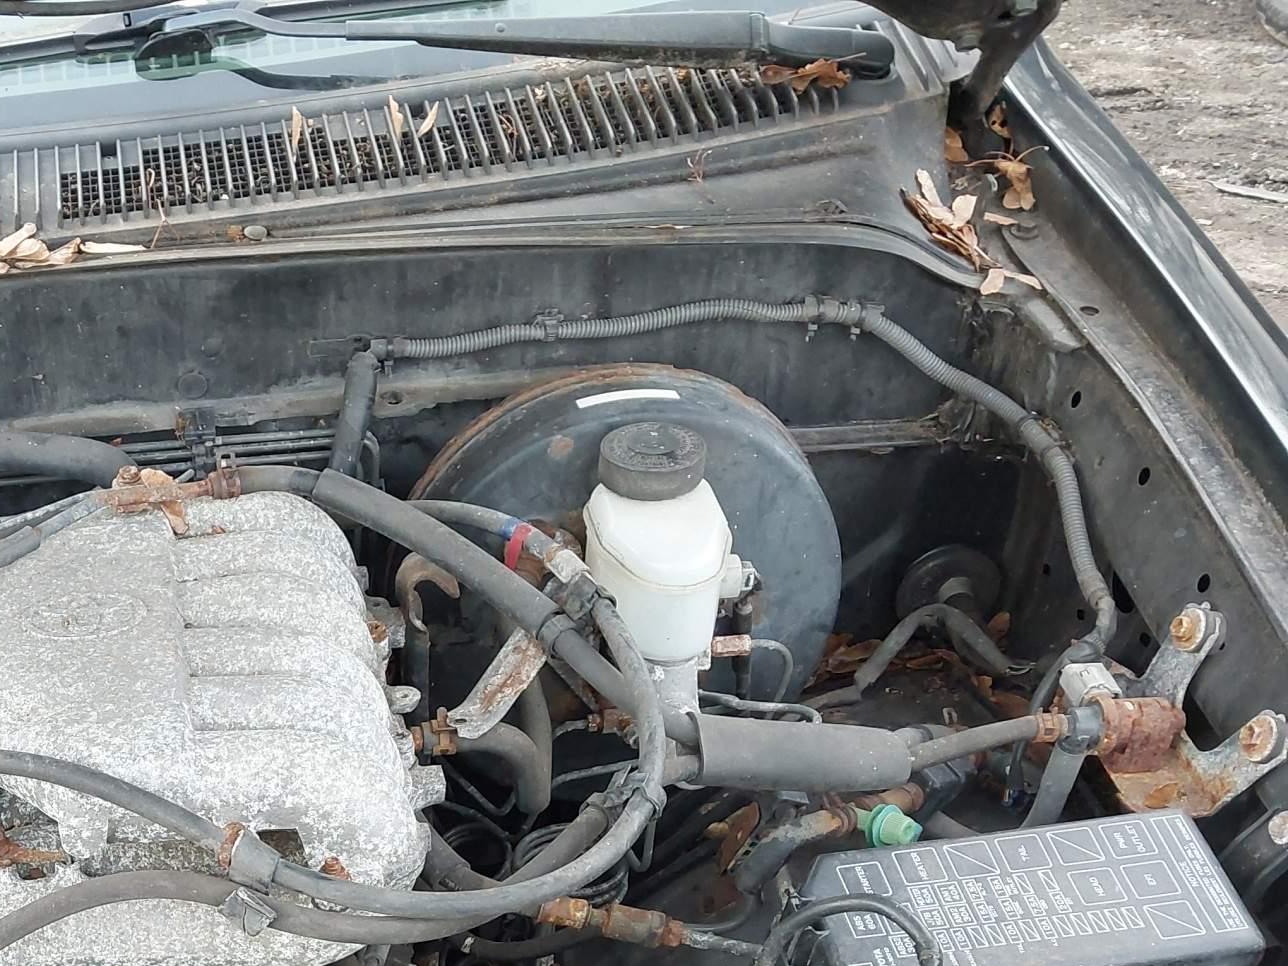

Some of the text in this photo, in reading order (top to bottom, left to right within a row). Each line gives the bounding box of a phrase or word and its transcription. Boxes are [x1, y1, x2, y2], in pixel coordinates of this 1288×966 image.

[1113, 832, 1128, 849] PWR
[1125, 824, 1147, 853] OUTLET
[1018, 845, 1030, 862] TAIL
[911, 852, 929, 880] HEATER
[1178, 861, 1201, 888] NOTICE
[854, 865, 874, 894] STARTER
[1089, 876, 1106, 897] HEAD
[921, 887, 933, 904] 50A
[940, 887, 953, 902] AM1
[948, 884, 961, 900] 40A
[1053, 893, 1067, 911] 20A
[853, 915, 866, 931] ABS
[863, 913, 876, 930] 60A
[923, 912, 936, 926] J/B
[932, 909, 945, 926] 50A
[950, 908, 962, 926] AM2
[958, 906, 972, 923] 30A
[1006, 924, 1018, 941] 10A
[1041, 920, 1053, 938] 10A
[894, 936, 906, 955] ABS2
[938, 932, 950, 949] 10A
[955, 931, 967, 947] 10A
